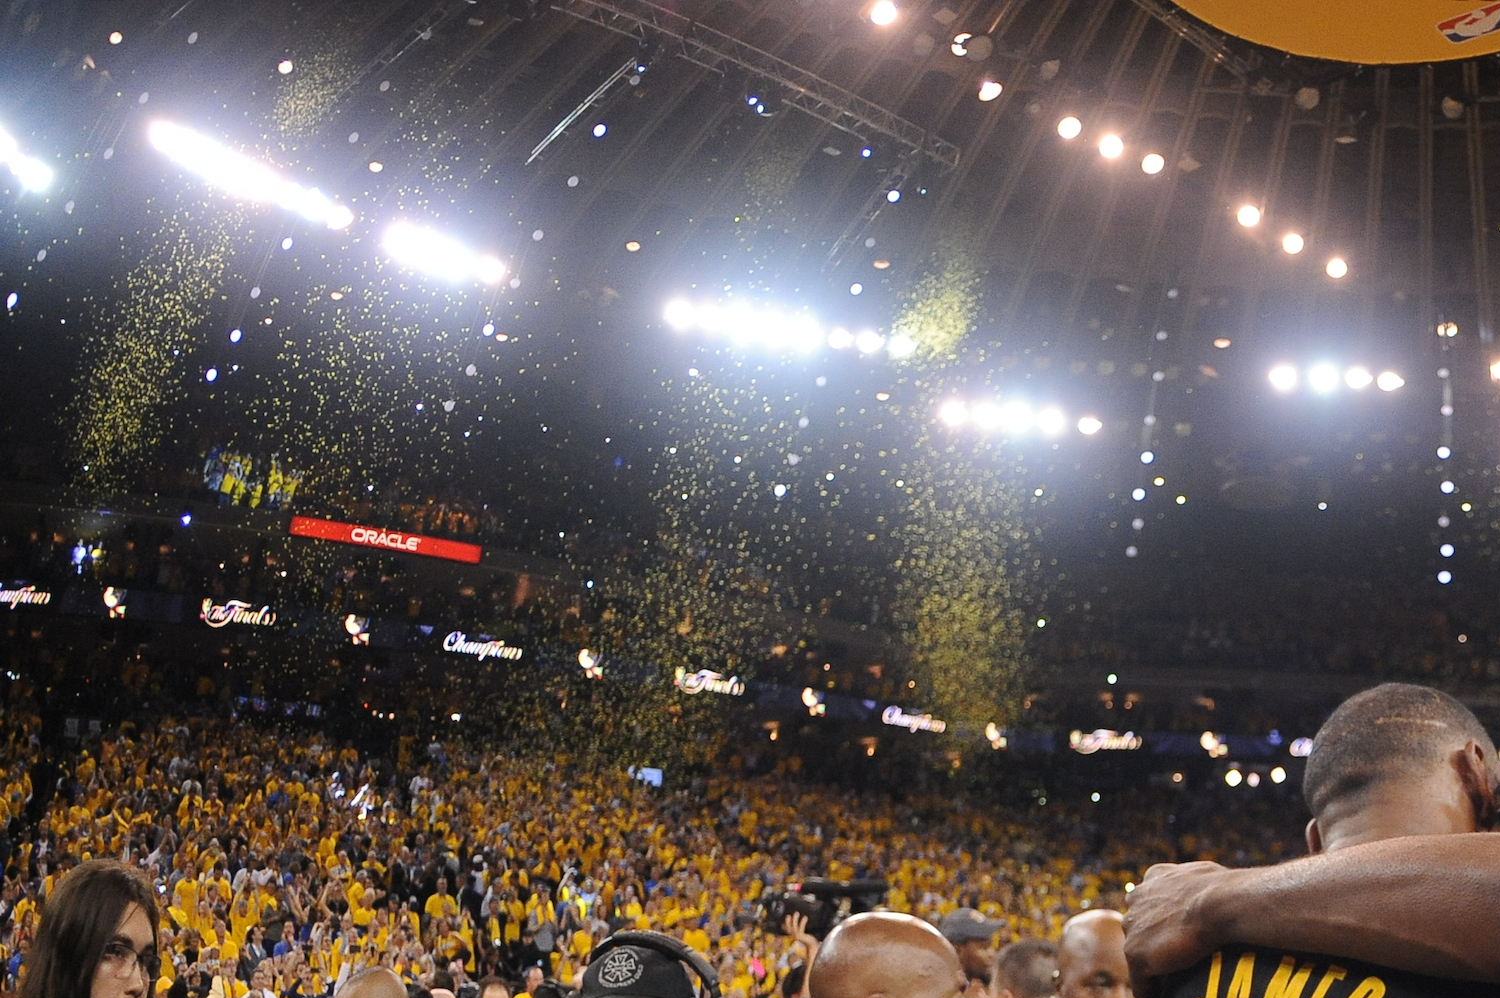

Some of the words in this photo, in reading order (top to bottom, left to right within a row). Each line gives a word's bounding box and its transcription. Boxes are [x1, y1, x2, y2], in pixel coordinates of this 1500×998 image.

[351, 528, 418, 551] ORACLE
[0, 585, 51, 609] ampions
[220, 600, 272, 627] Finals
[442, 630, 523, 662] Champions
